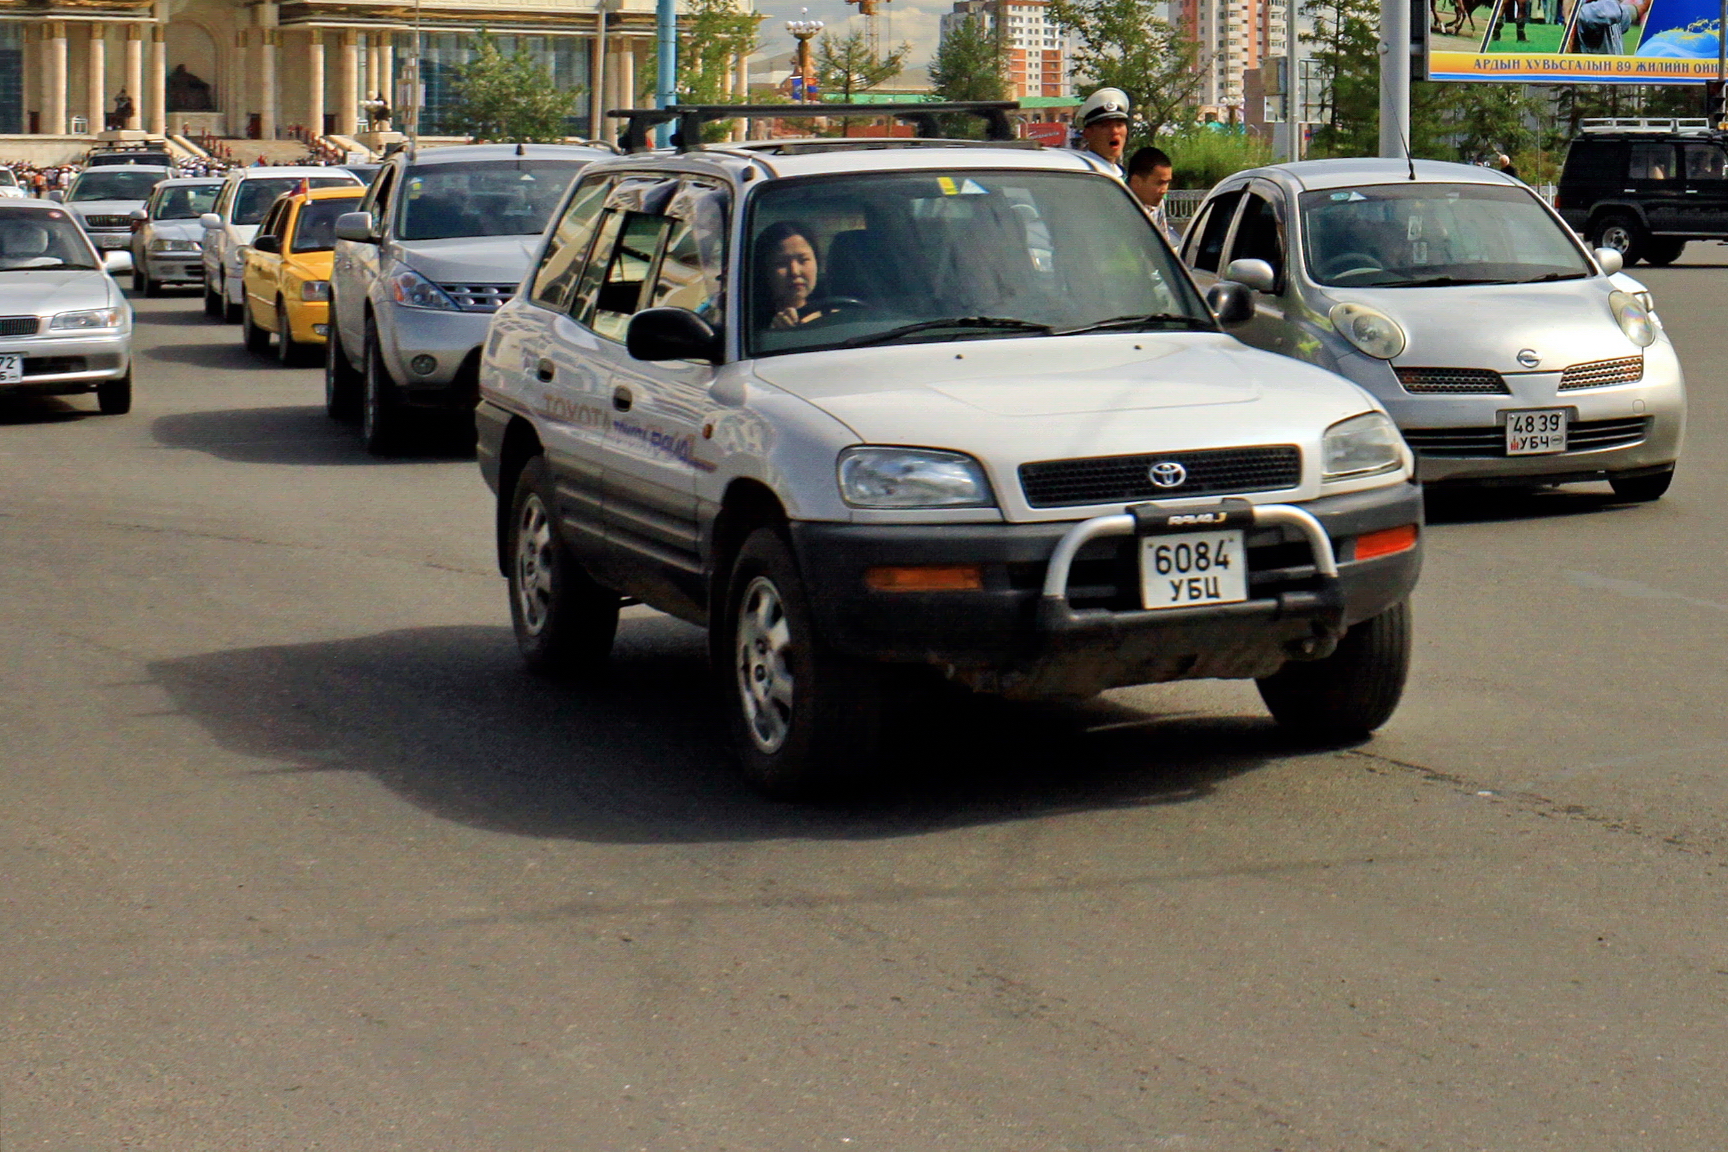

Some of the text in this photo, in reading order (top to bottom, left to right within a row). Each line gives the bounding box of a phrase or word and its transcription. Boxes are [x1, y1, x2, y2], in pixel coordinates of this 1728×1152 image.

[1473, 58, 1521, 70] АРДЫН
[1525, 59, 1612, 71] ХУВЬСГАЛЫН
[1616, 61, 1631, 72] 89
[1635, 60, 1689, 73] ЖИЛИЙН
[1693, 60, 1719, 74] ОЙН
[1514, 414, 1560, 433] 4839
[1520, 435, 1549, 450] УБЧ
[1155, 539, 1230, 575] 6084
[1169, 576, 1221, 602] УБЦ
